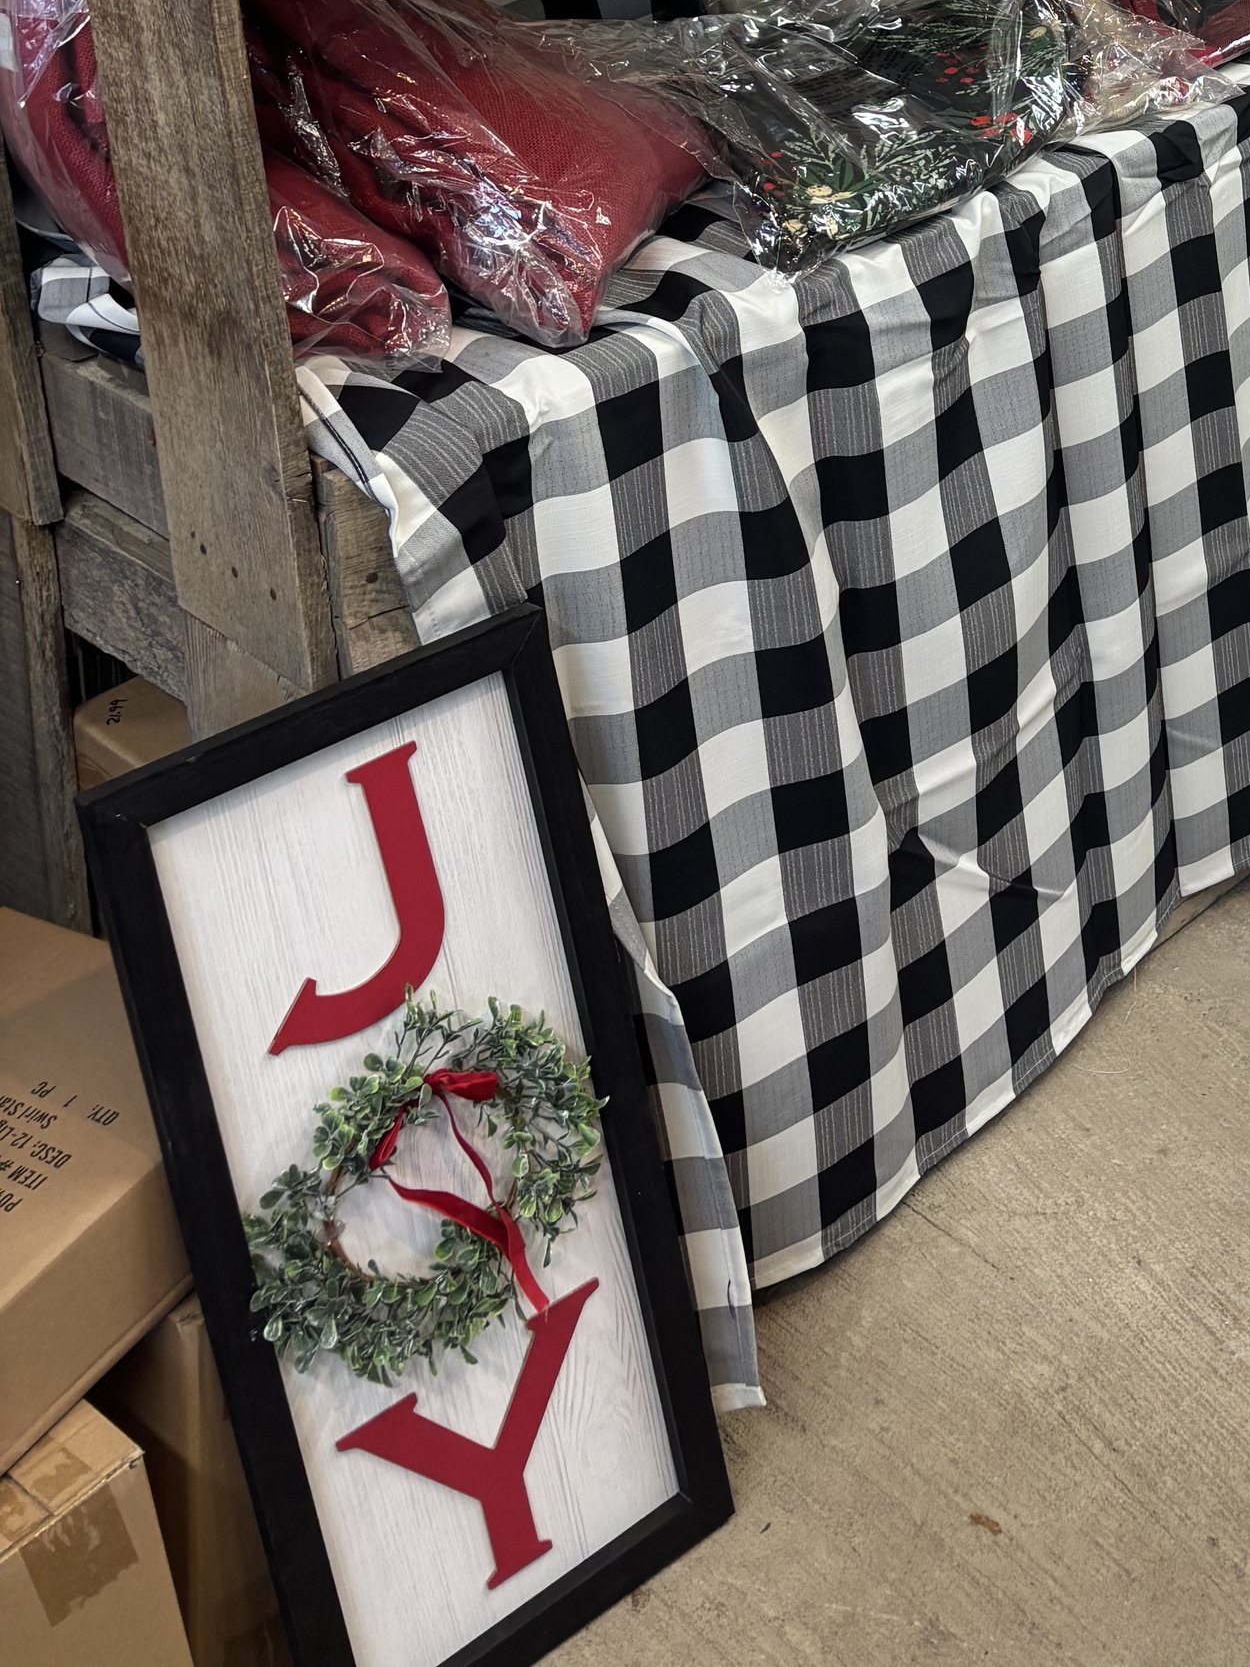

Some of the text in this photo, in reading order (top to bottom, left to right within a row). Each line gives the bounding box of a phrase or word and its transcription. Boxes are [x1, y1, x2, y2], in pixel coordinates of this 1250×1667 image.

[30, 1081, 120, 1126] QTY: 1 PC
[17, 1105, 58, 1130] Swirl
[30, 1140, 72, 1169] DESC:
[7, 1165, 48, 1191] ITEM
